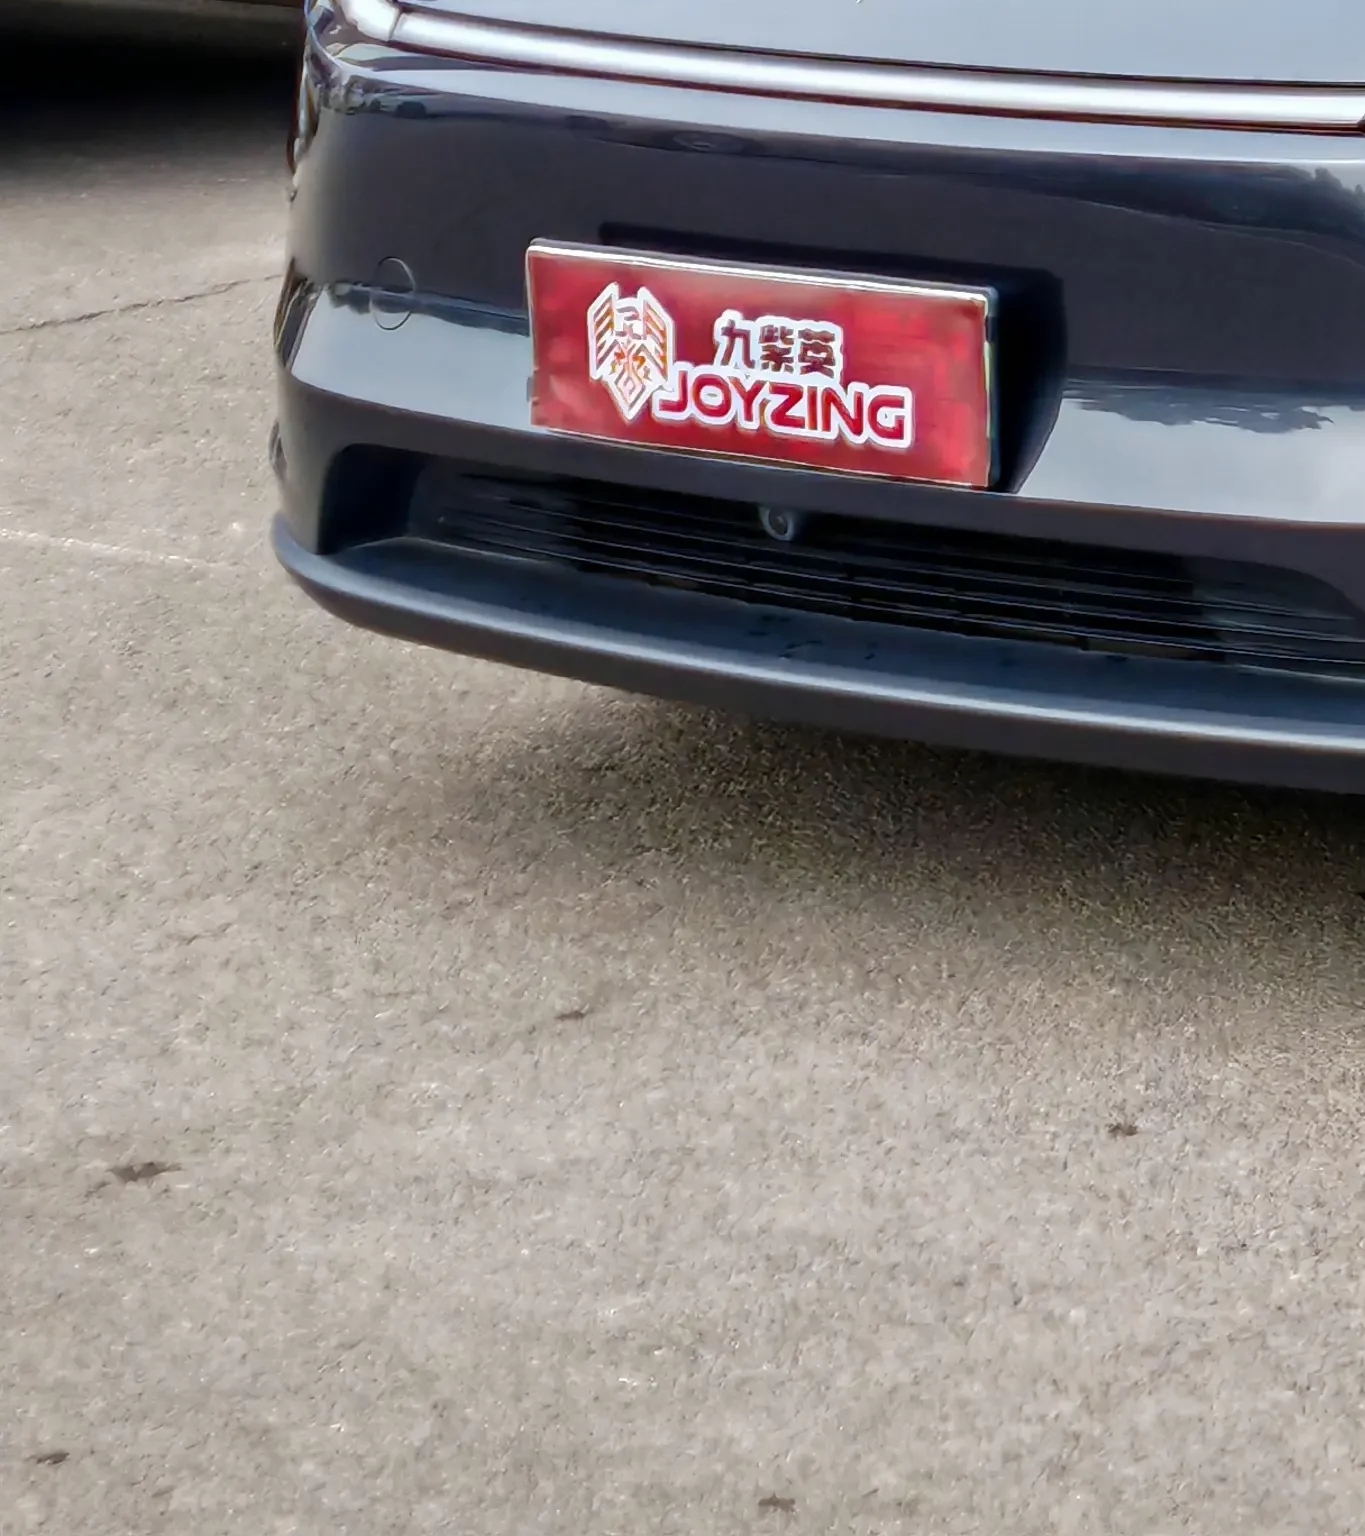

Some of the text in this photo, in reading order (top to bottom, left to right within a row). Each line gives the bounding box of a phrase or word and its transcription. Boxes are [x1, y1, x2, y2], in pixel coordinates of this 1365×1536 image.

[715, 315, 841, 379] 九紫英
[655, 369, 909, 444] JOYZING
